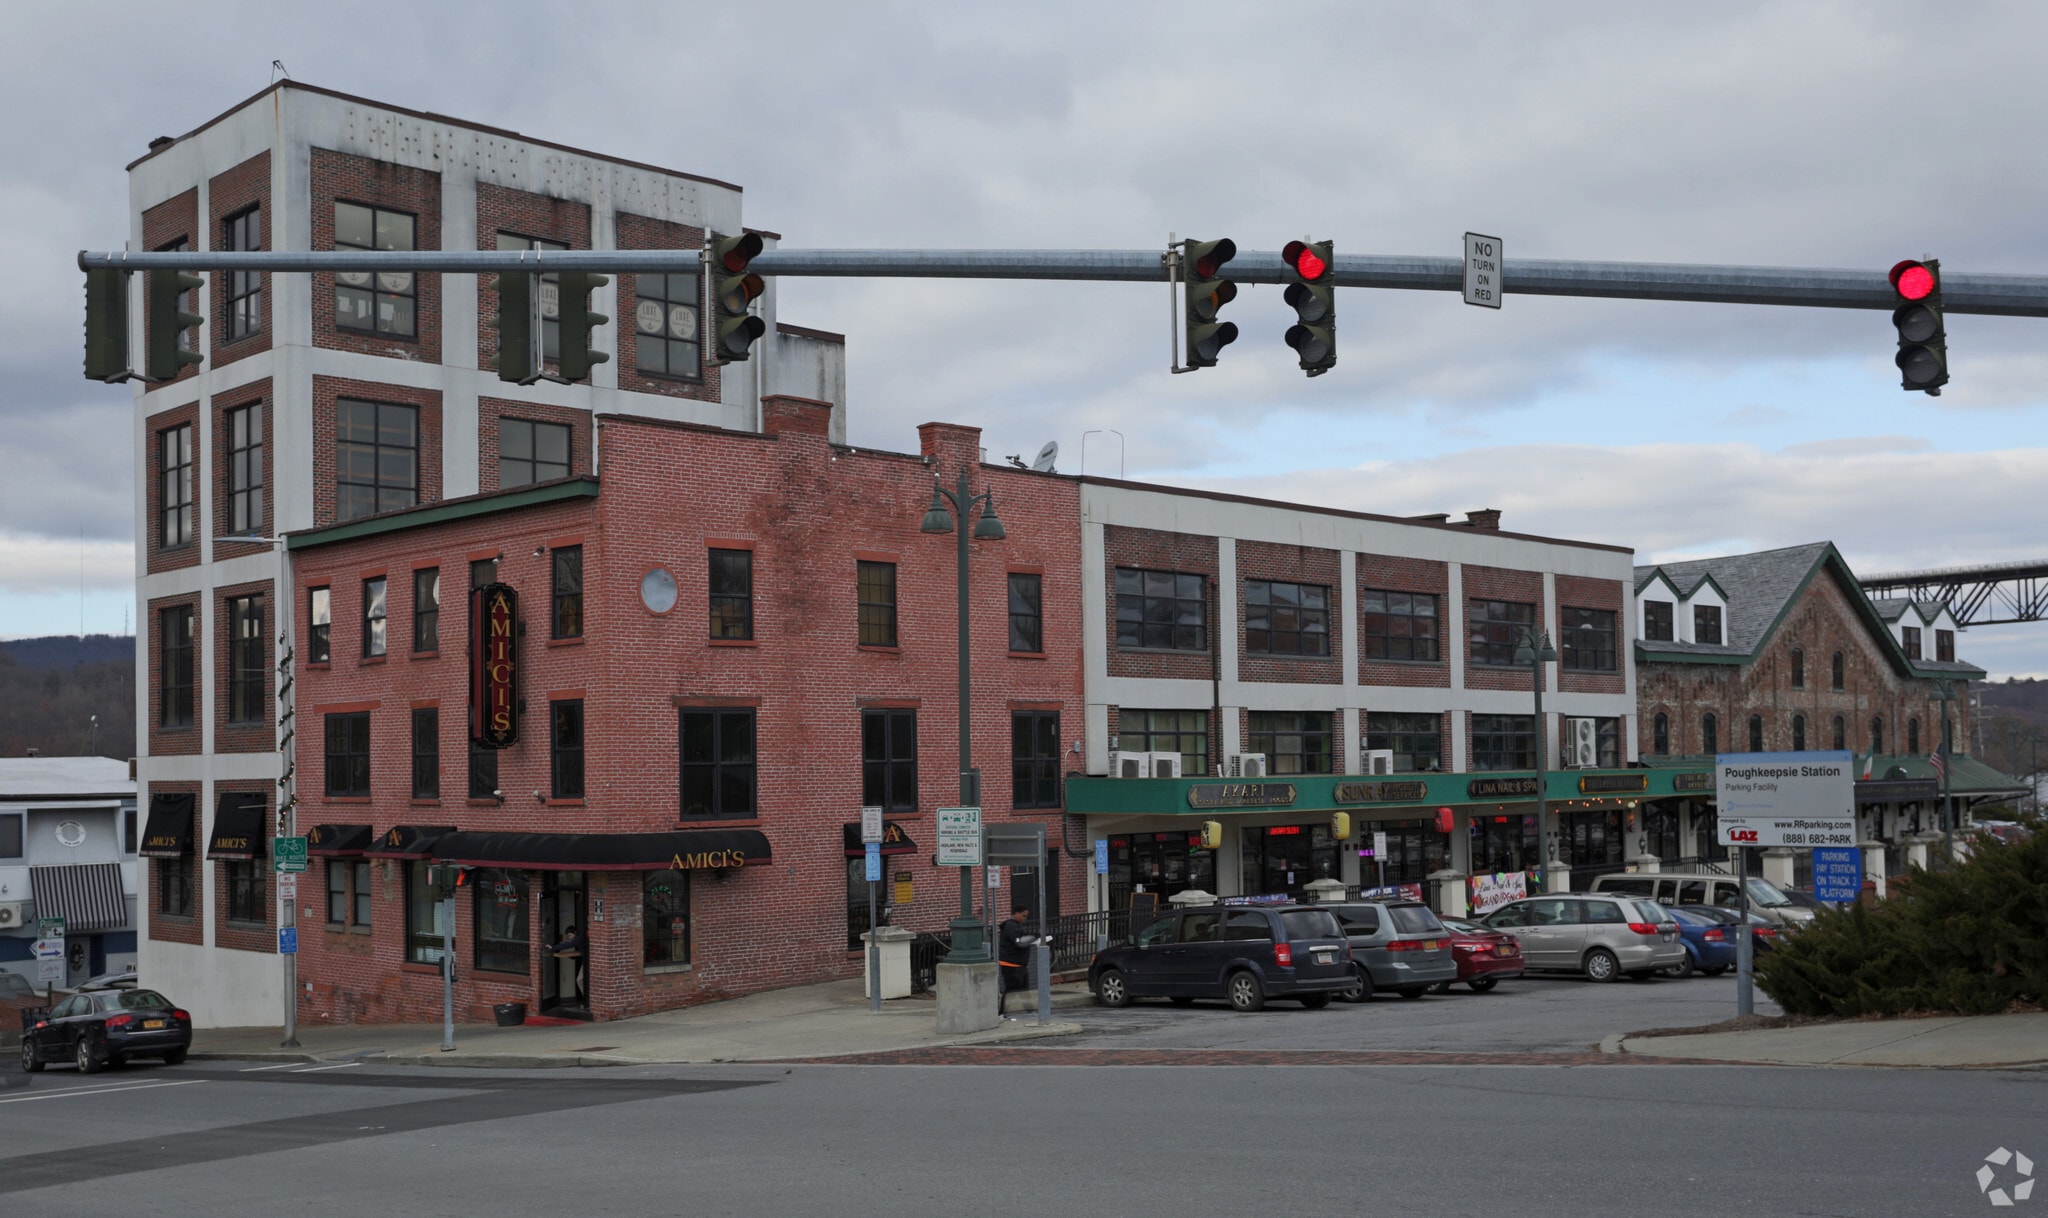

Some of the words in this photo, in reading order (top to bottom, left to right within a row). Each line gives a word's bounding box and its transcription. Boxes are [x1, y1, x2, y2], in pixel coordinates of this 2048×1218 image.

[1475, 242, 1492, 257] NO
[1472, 258, 1495, 272] TURN
[1477, 274, 1489, 285] ON
[542, 288, 557, 300] LUXE
[1475, 288, 1491, 300] RED
[642, 303, 657, 316] LUXE
[675, 310, 690, 323] LUXE
[490, 594, 511, 731] AMICI'S
[1725, 766, 1798, 780] Poughkeepsie
[1801, 765, 1841, 777] Station
[1222, 784, 1265, 797] AKARI
[1479, 783, 1497, 794] LINA
[1497, 781, 1515, 793] NAIL
[1516, 781, 1521, 791] &
[1522, 780, 1538, 792] SPA
[1725, 783, 1752, 793] Parking
[1753, 782, 1778, 793] Facility
[1774, 820, 1852, 831] www.RRparking.com
[884, 824, 901, 843] A
[1730, 830, 1758, 842] LAZ
[1782, 833, 1806, 845] (888)
[1809, 834, 1852, 844] 682-PARK
[669, 848, 745, 870] AMICI'S
[1821, 852, 1850, 862] PARKING
[1816, 864, 1828, 873] PAY
[1829, 864, 1856, 874] STATION
[1816, 876, 1827, 886] ON
[1828, 876, 1850, 886] TRACK
[1852, 876, 1857, 886] 2
[1820, 888, 1855, 898] PLATFORM
